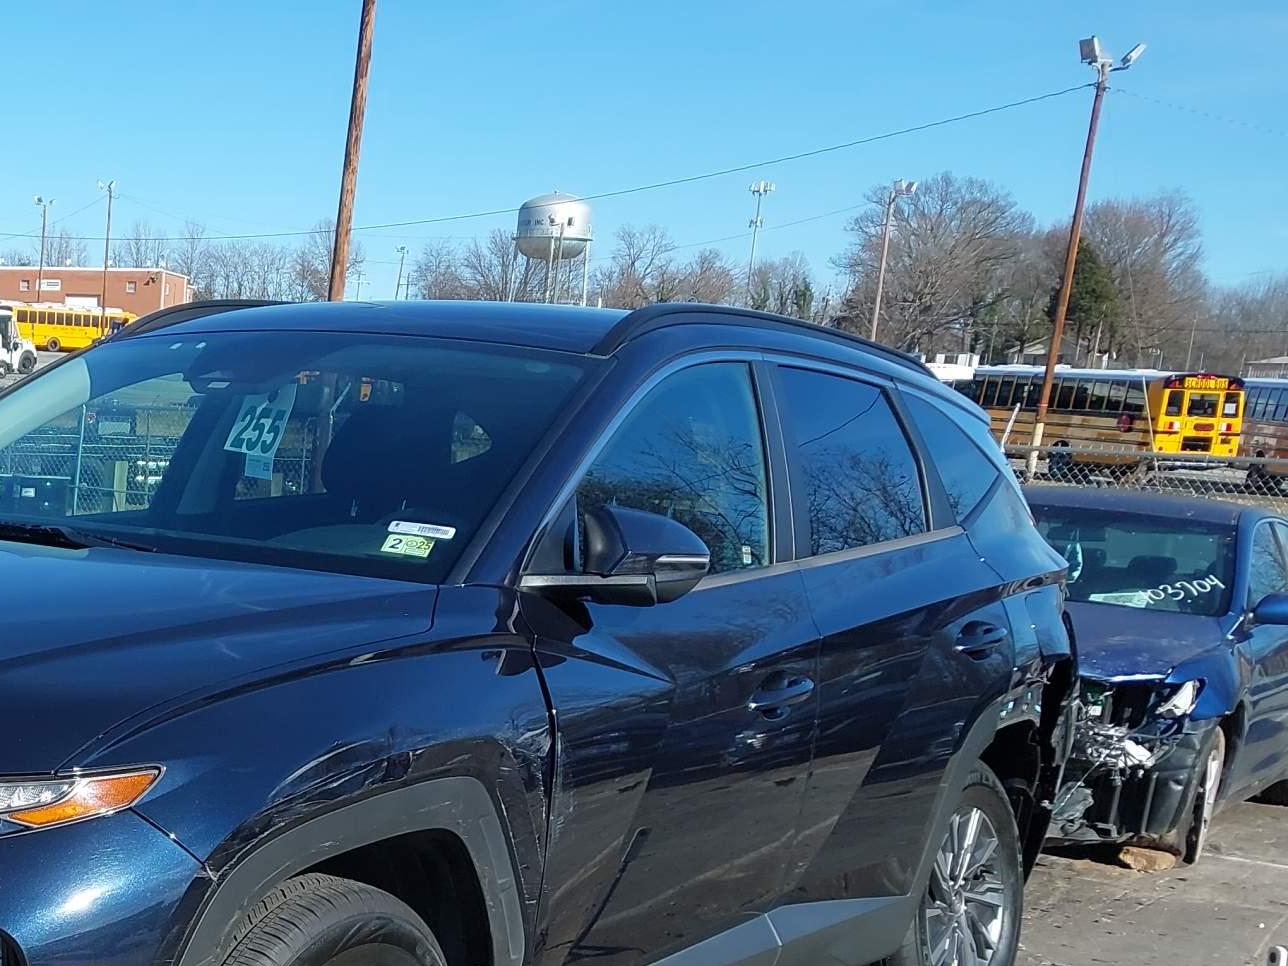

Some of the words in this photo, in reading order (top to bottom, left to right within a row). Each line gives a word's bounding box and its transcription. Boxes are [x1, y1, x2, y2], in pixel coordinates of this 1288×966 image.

[1187, 378, 1211, 389] SCHOOL
[1214, 379, 1227, 390] BUS
[229, 405, 287, 455] 255
[388, 538, 403, 550] 2
